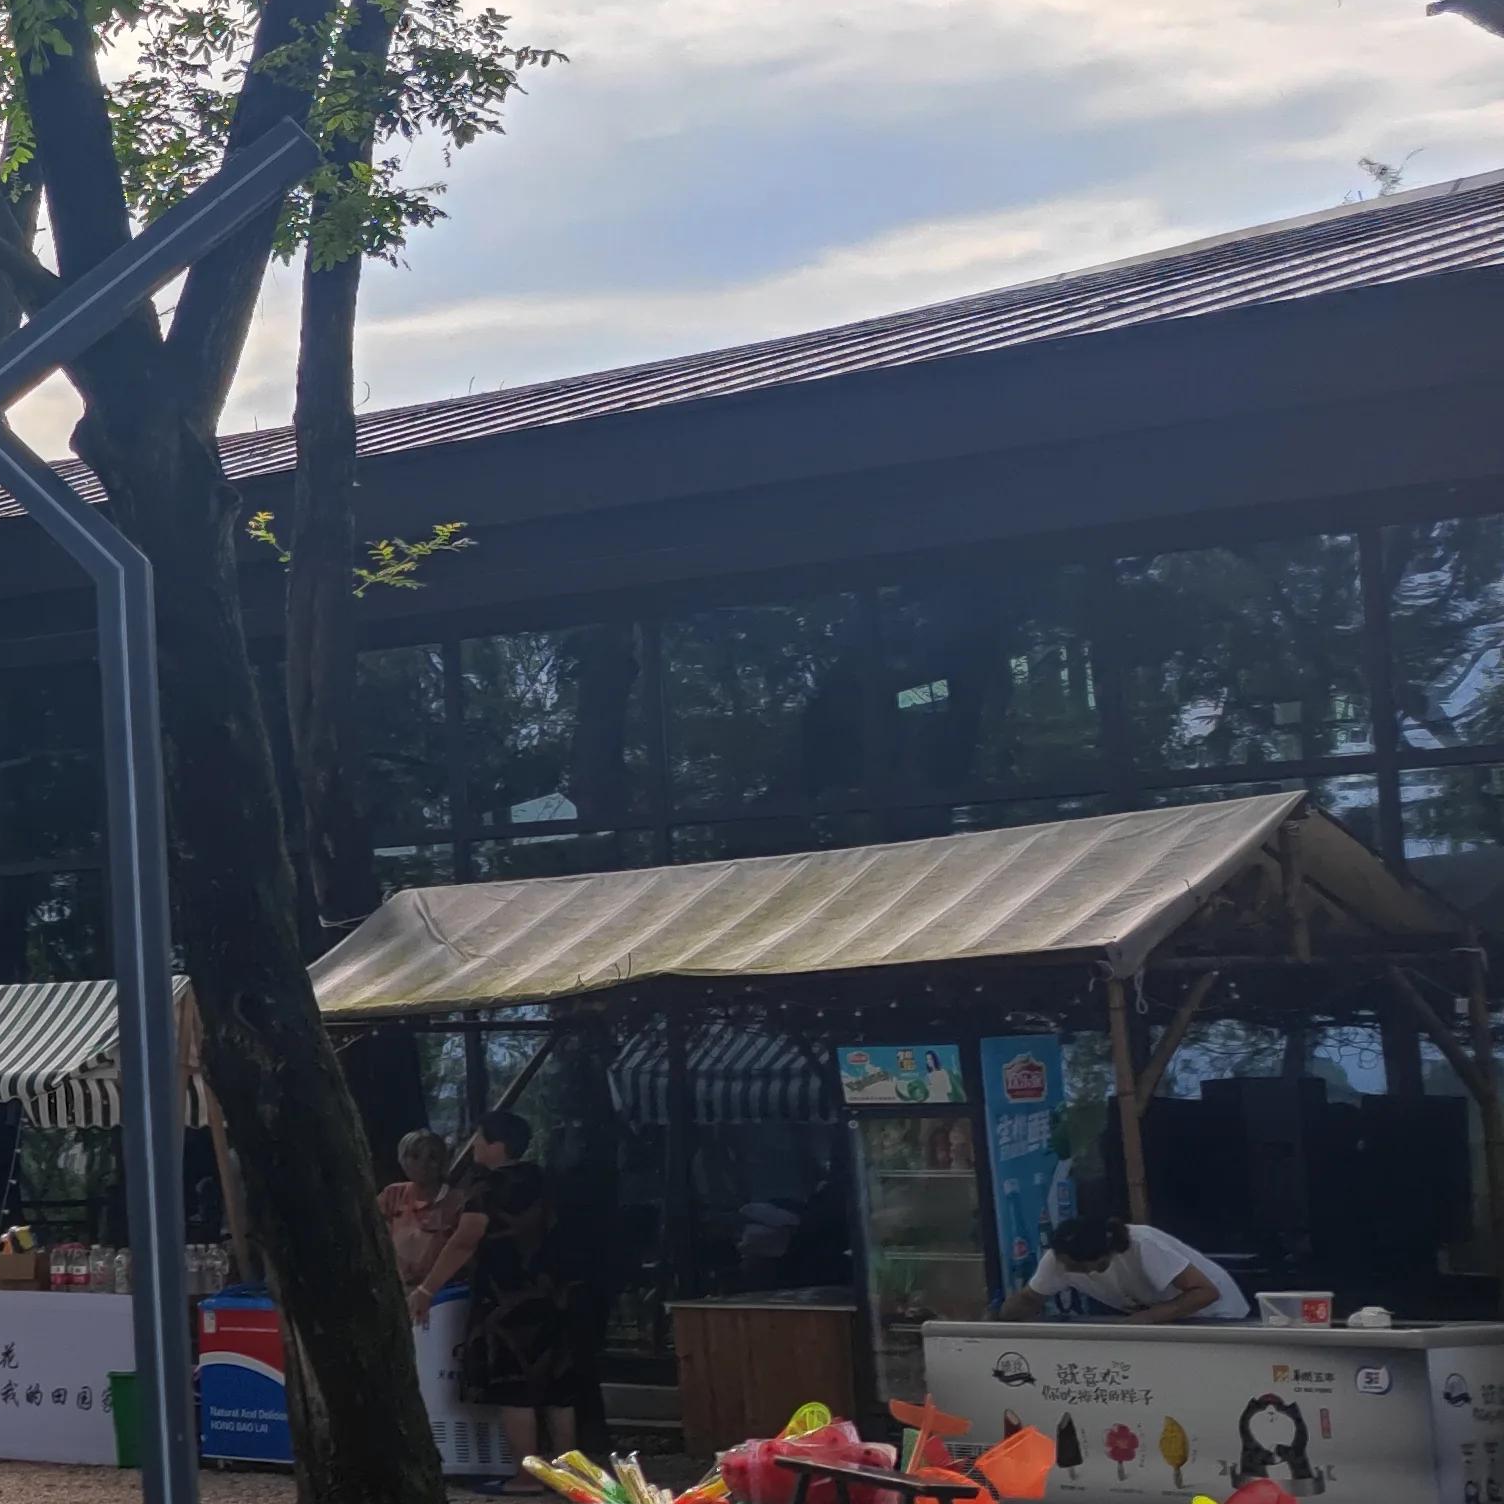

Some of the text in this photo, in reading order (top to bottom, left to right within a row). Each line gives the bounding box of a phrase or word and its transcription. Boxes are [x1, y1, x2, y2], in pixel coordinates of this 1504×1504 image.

[1055, 1362, 1122, 1387] 就喜欢
[209, 1406, 239, 1417] Natural
[210, 1420, 235, 1431] HONG
[255, 1423, 268, 1433] LAI
